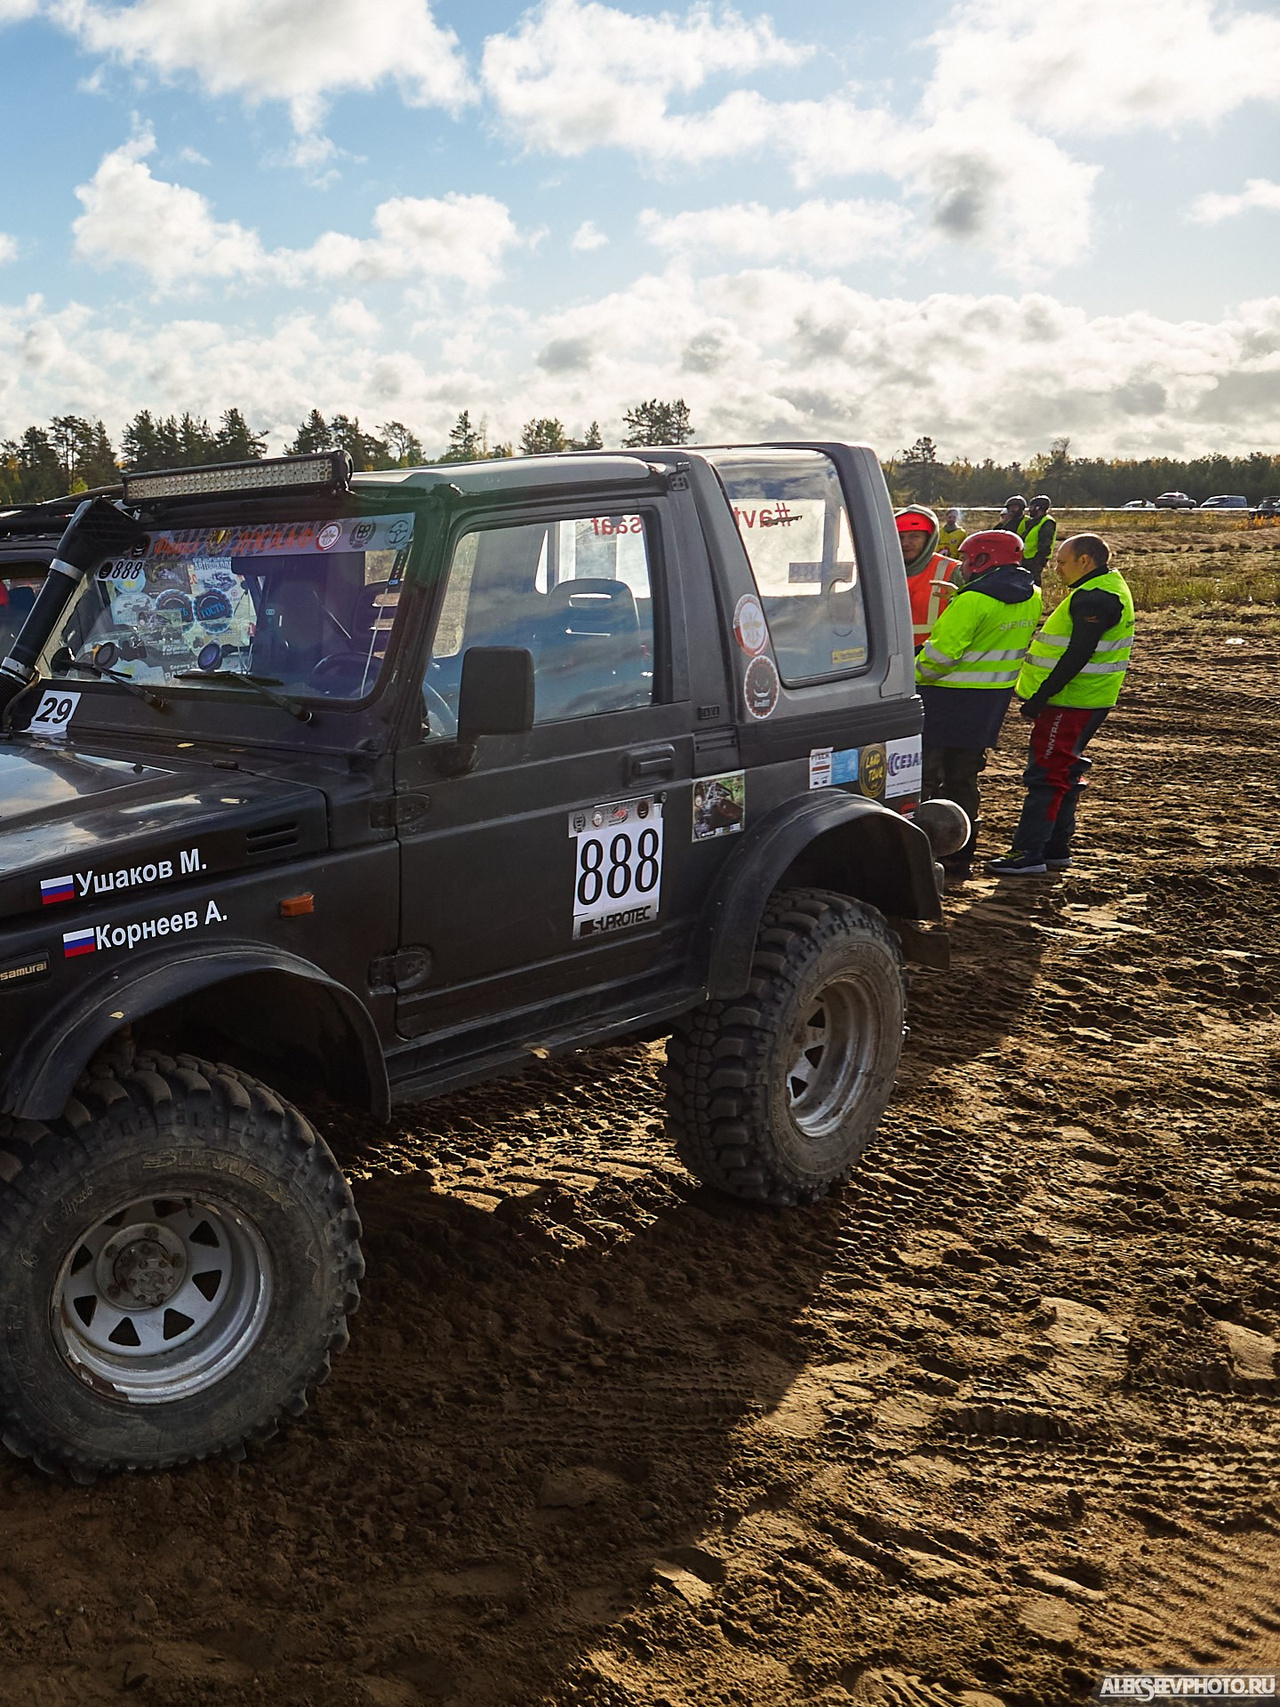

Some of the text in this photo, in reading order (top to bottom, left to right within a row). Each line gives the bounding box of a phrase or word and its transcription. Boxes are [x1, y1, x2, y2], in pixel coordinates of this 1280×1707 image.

[111, 561, 143, 580] 888
[200, 600, 226, 618] ГОСТЬ
[34, 697, 73, 724] 29
[75, 848, 208, 897] Ушаков М.
[577, 827, 660, 906] 888
[95, 900, 228, 950] Корнеев А.
[592, 905, 652, 931] SUPROTEC
